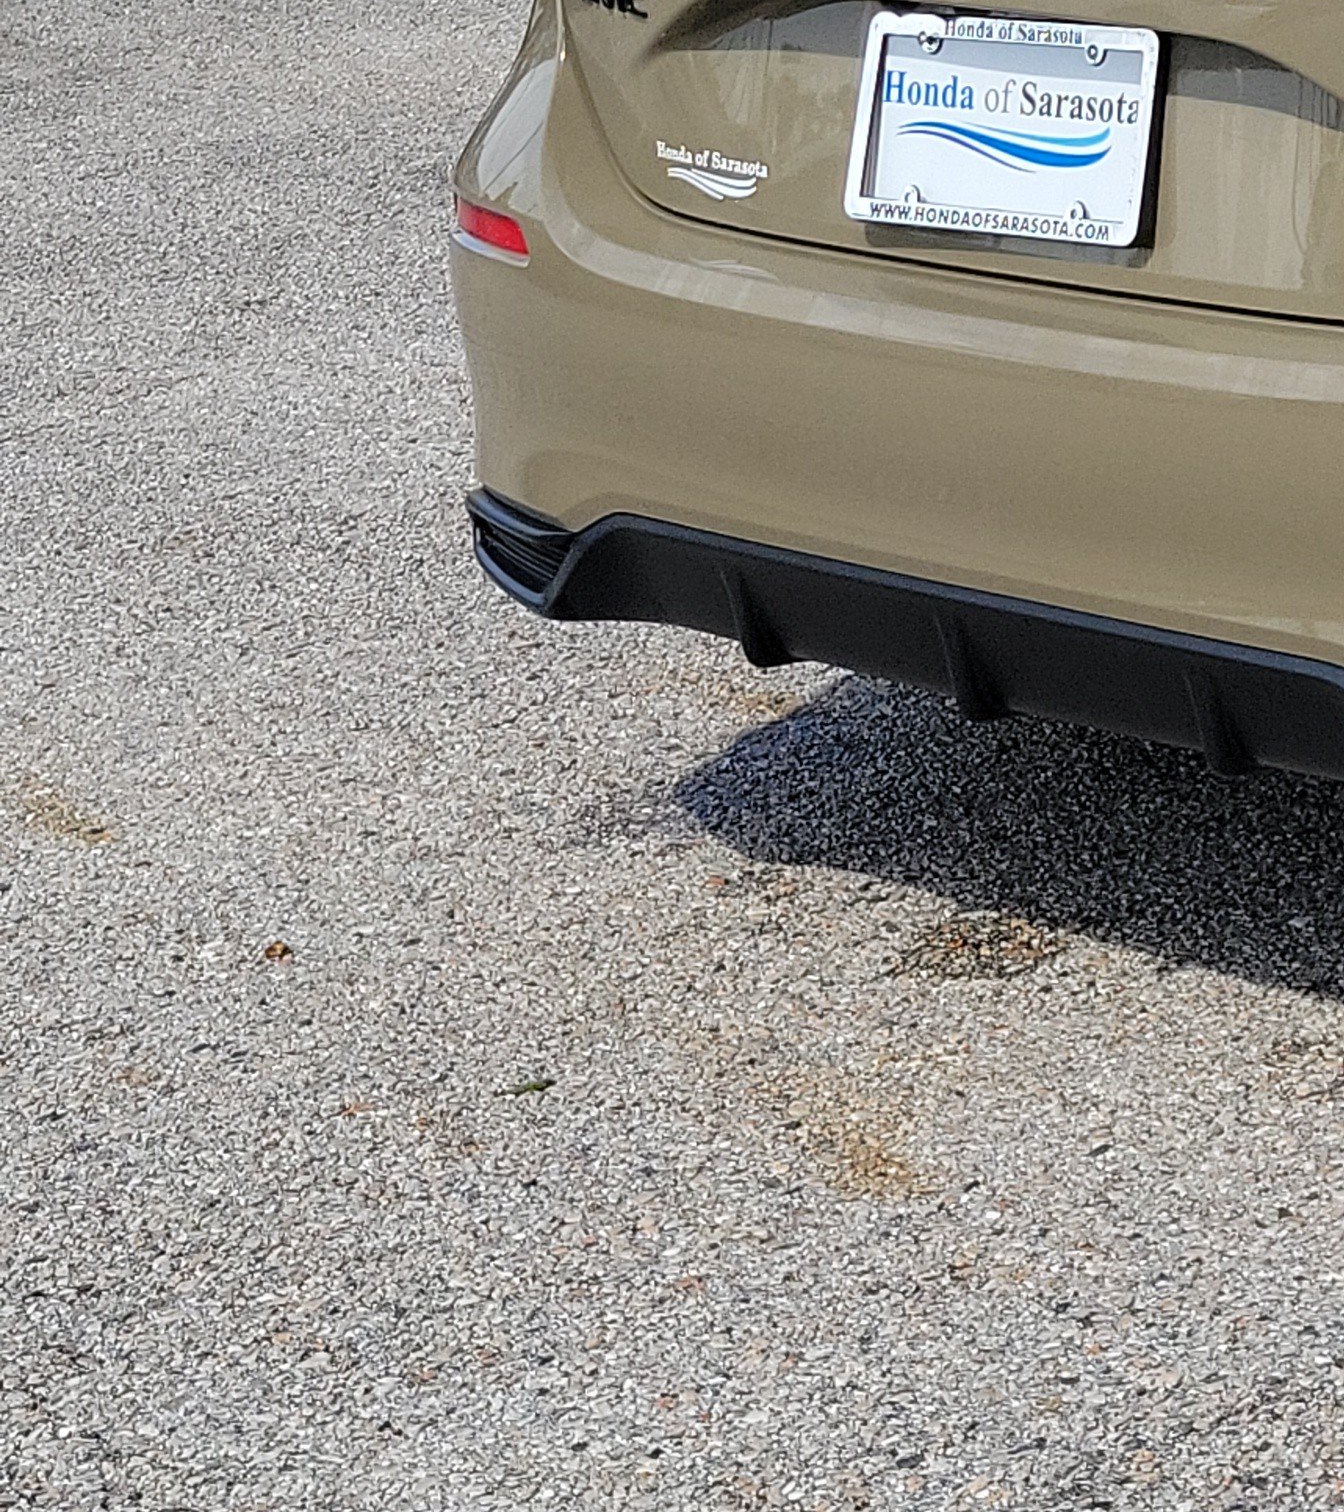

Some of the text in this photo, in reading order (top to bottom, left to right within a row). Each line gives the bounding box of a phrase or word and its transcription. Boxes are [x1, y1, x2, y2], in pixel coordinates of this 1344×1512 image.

[945, 18, 1082, 45] Honda of Sarasota
[884, 70, 1140, 125] Honda of Sarasota
[656, 141, 768, 178] Honda of Sarasota
[869, 201, 1110, 241] WWW.HONDAOFSARASOTA.COM
